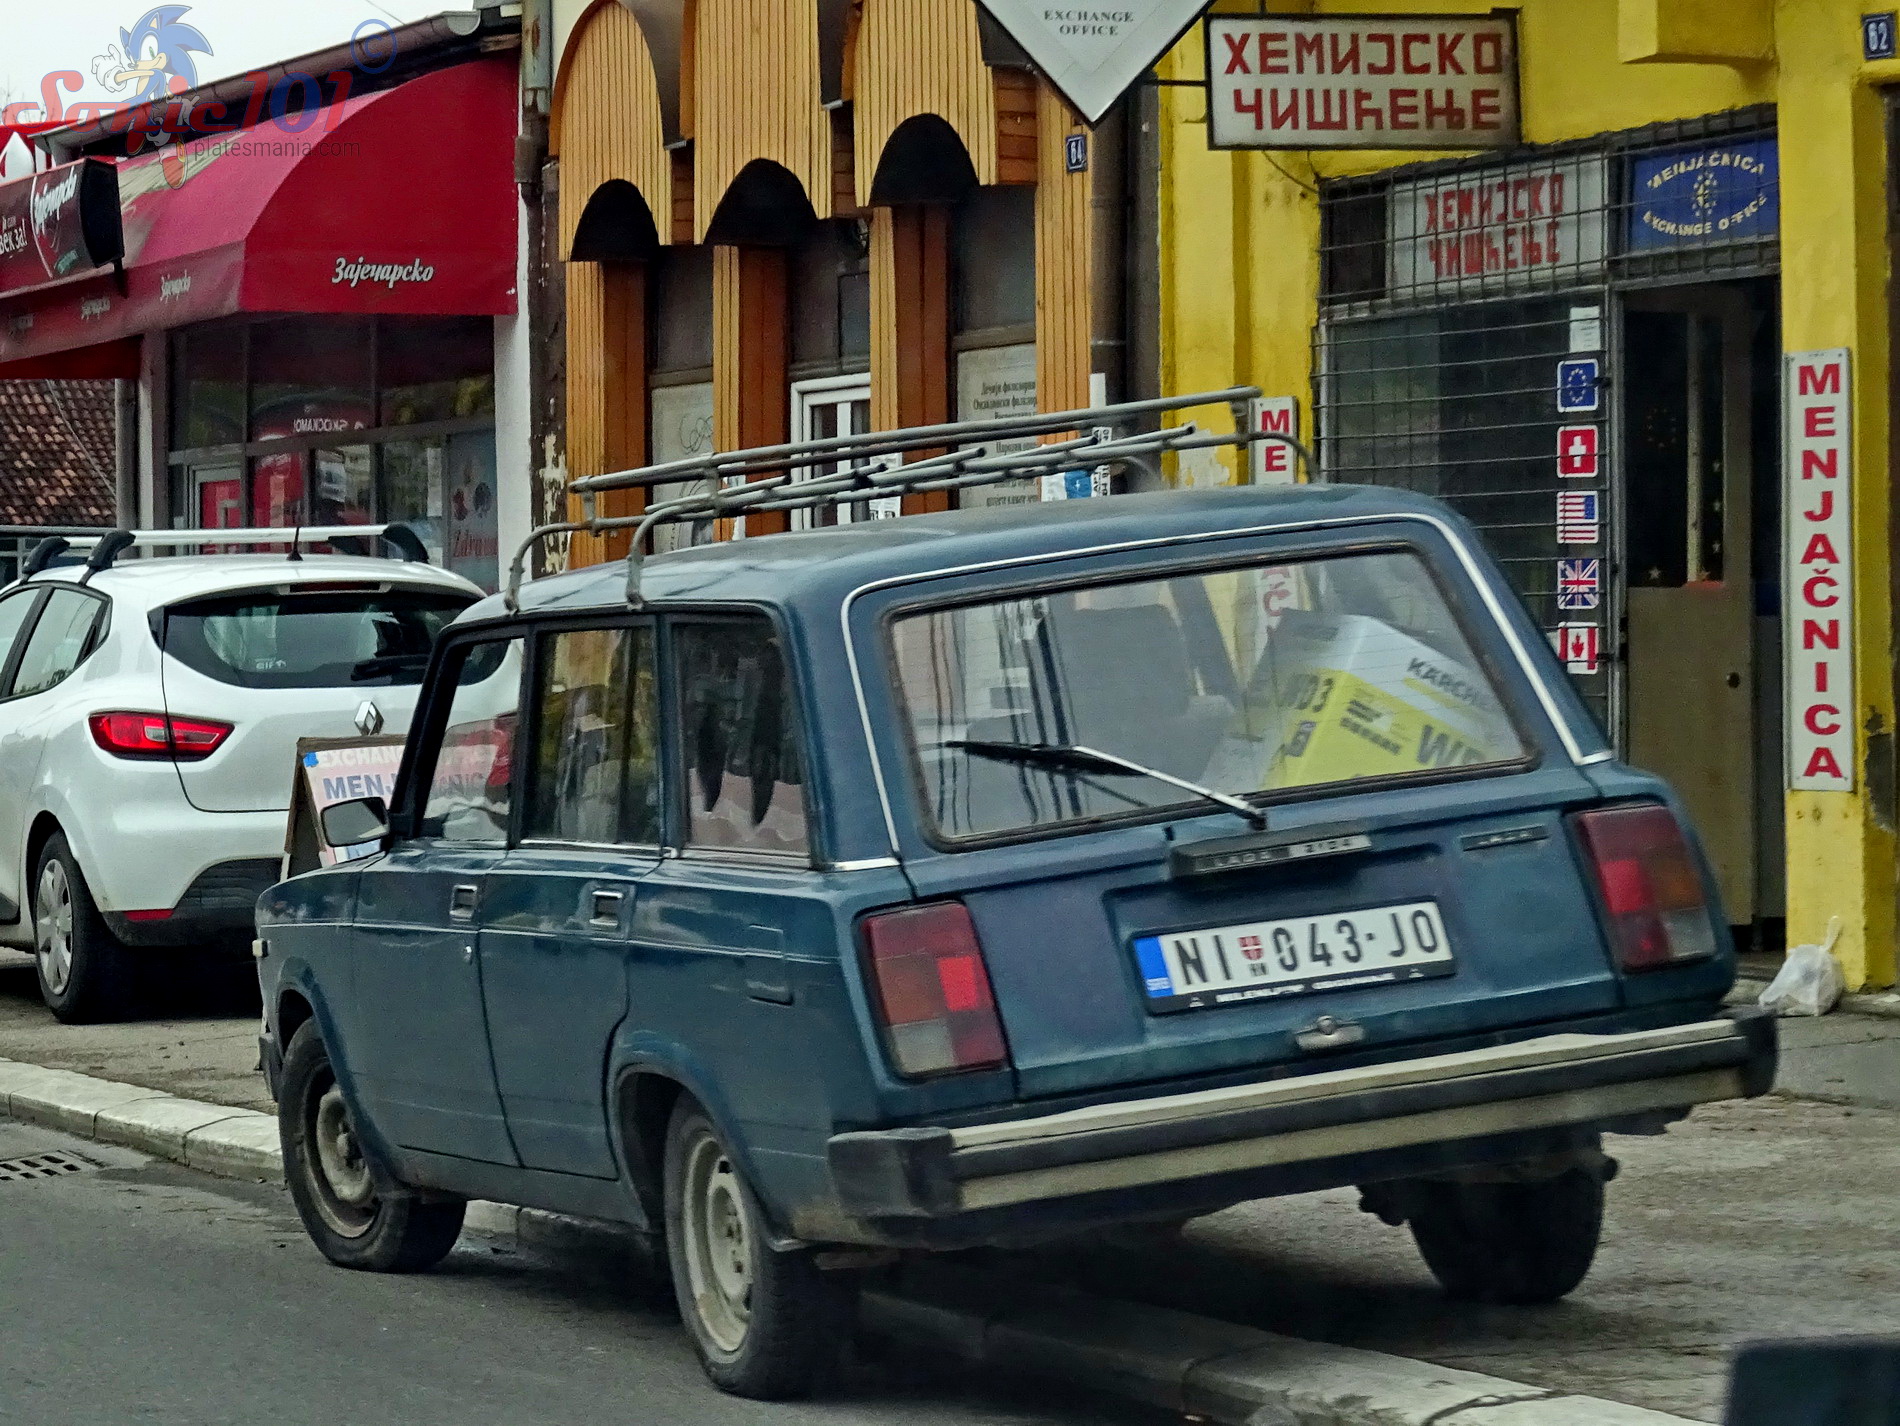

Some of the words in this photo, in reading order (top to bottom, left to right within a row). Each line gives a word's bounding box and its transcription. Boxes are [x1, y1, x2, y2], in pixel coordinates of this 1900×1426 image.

[1044, 10, 1134, 22] EXCHANGE
[1059, 25, 1118, 36] OFFICE
[1222, 33, 1504, 75] ХЕМИЈСКО
[1232, 88, 1500, 130] ЧИШЋЕЊЕ
[331, 256, 434, 289] Зајечарско
[1798, 364, 1844, 779] MENJAČNICA
[1174, 934, 1232, 985] NI
